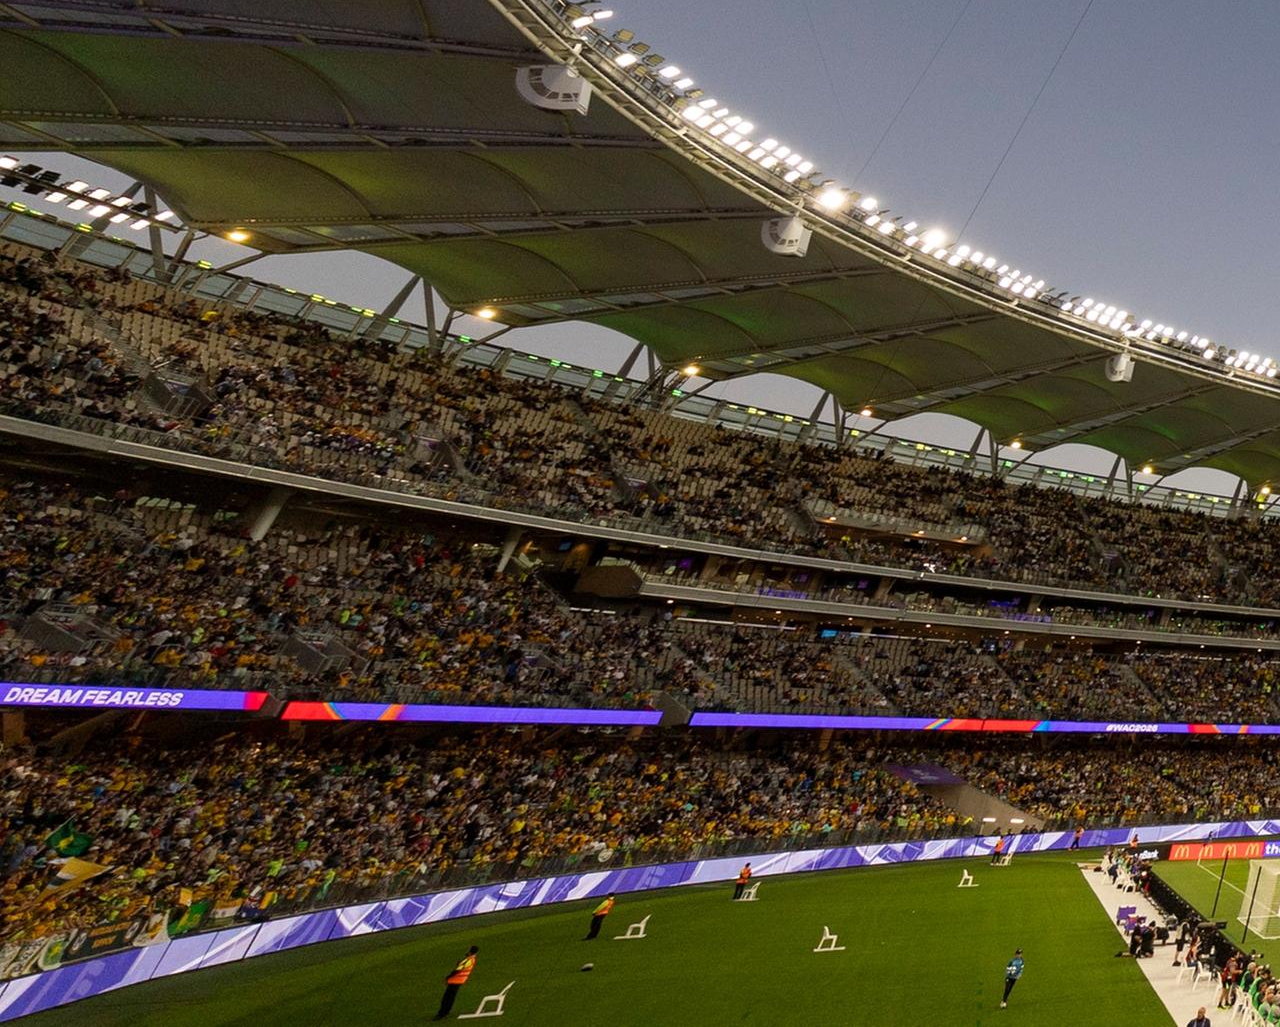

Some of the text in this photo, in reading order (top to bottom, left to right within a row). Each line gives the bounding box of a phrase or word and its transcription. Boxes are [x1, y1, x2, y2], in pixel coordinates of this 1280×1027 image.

[4, 687, 184, 706] DREAM FEARLESS
[1106, 724, 1158, 732] #WAC2026
